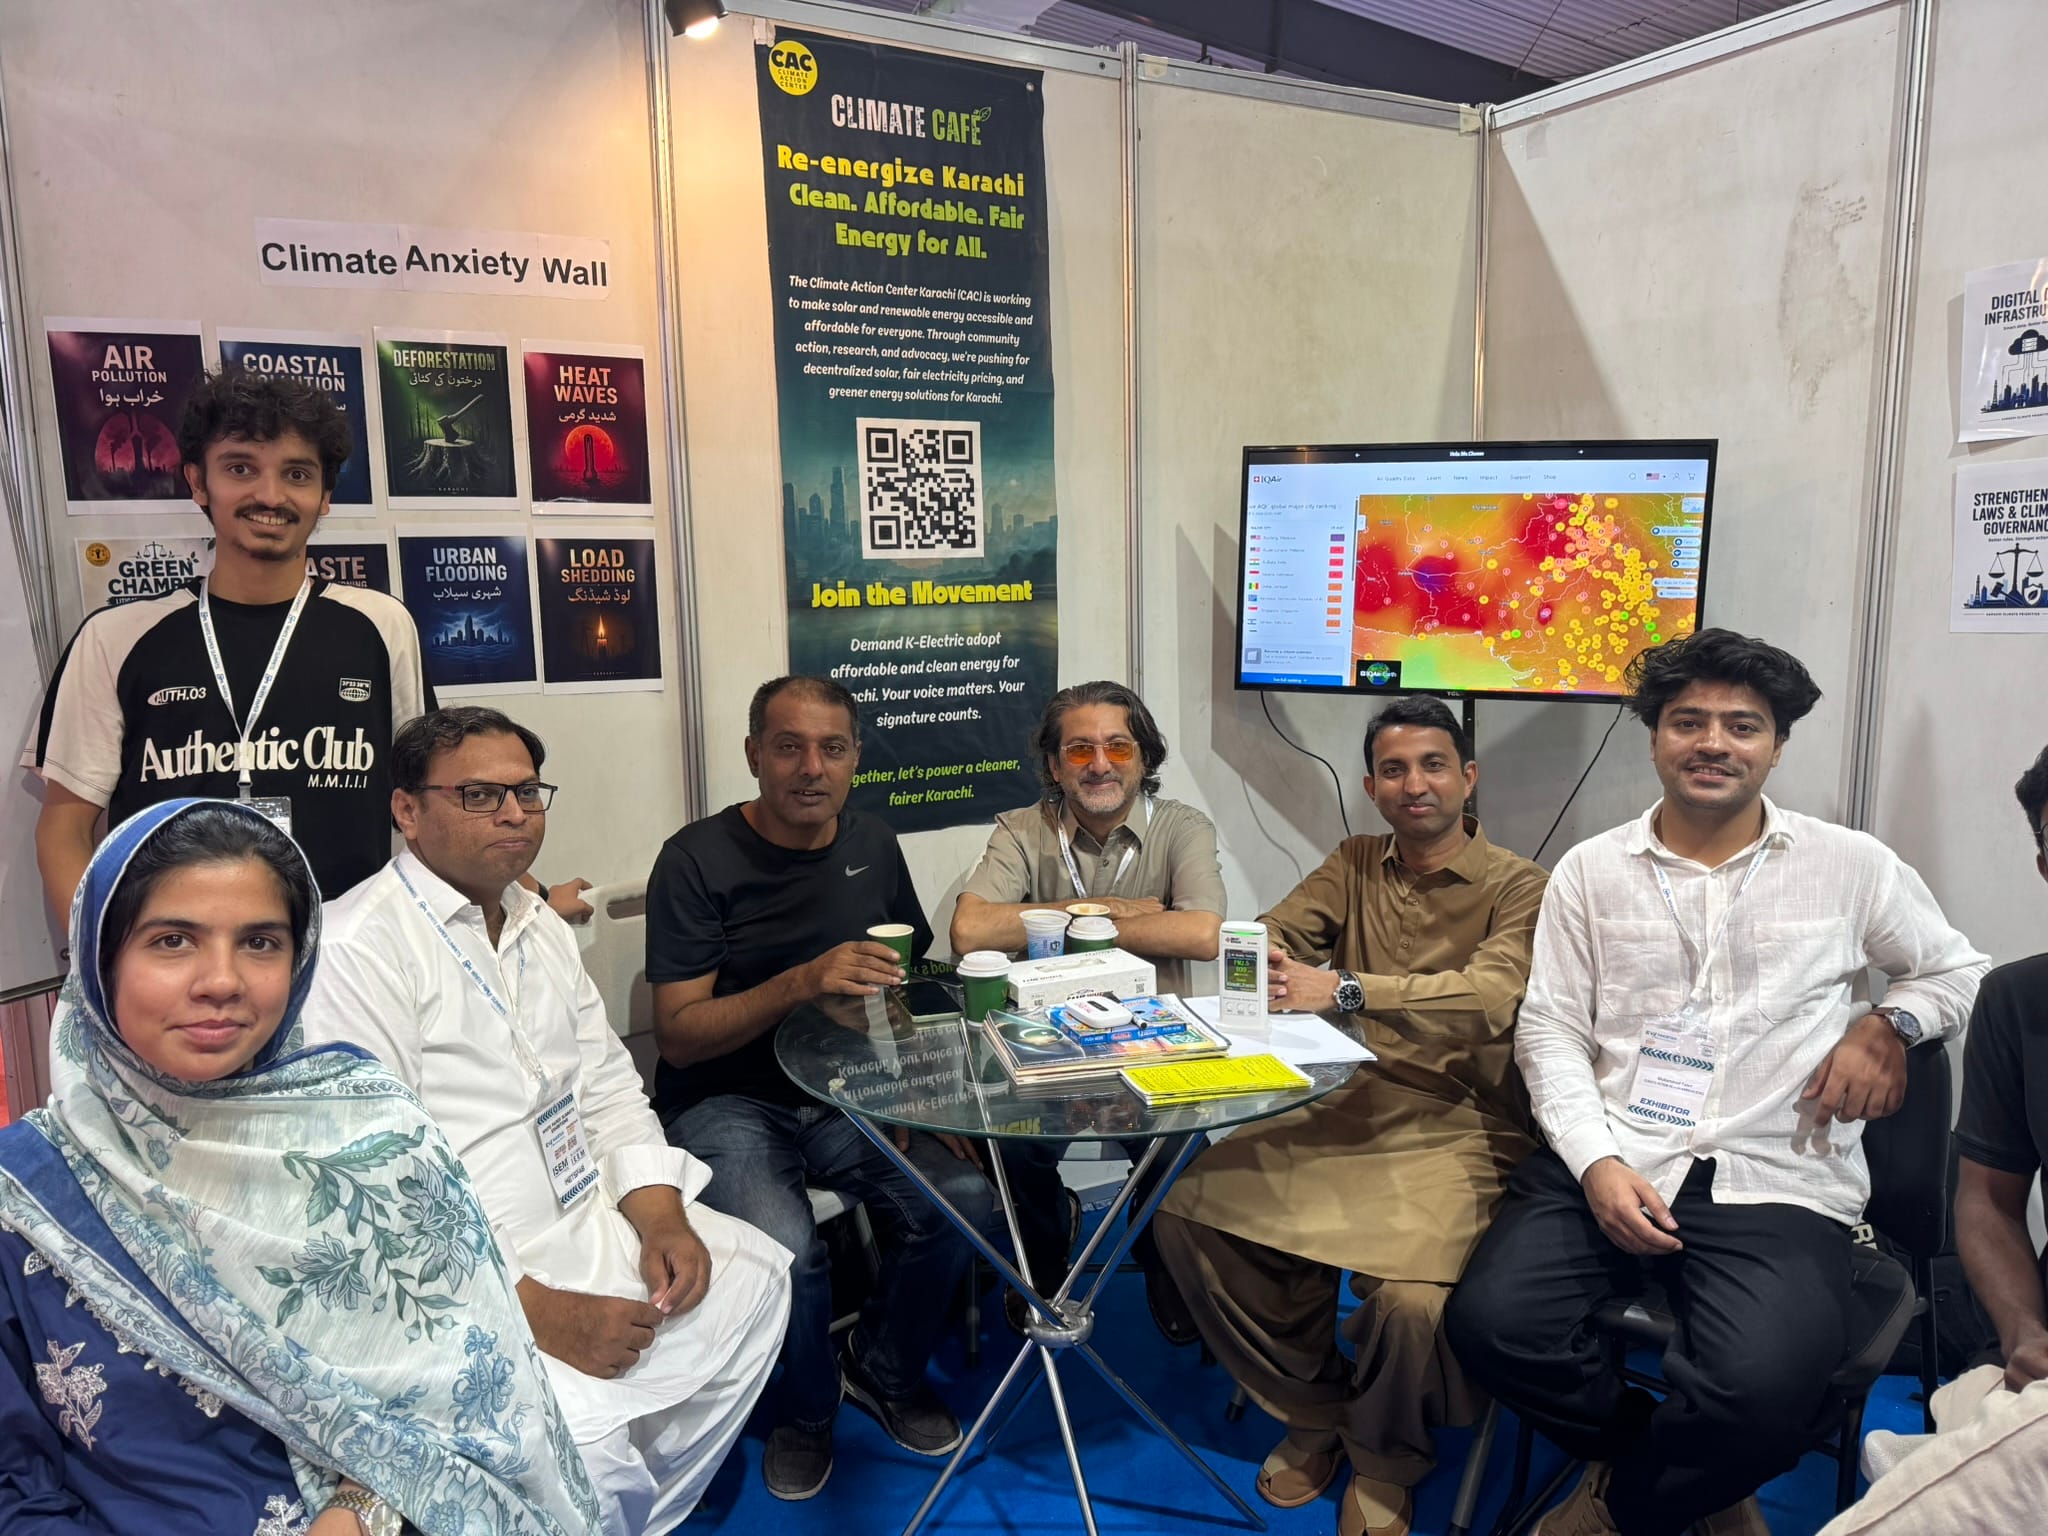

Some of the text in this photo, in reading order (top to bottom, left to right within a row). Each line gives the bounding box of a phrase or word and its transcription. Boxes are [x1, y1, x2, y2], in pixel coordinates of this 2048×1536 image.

[771, 50, 812, 71] CAC
[778, 69, 808, 78] CLIMATE
[780, 81, 807, 90] CENTER
[831, 94, 926, 138] CLIMATE
[777, 144, 1025, 197] Re-energize Karachi
[789, 183, 1025, 230] Clean. Affordable. Fair
[835, 222, 988, 259] Energy for All.
[262, 243, 607, 286] Climate Anxiety Wall
[789, 275, 1031, 307] The Climate Action Center Karachi (CAC) is working
[1991, 289, 2039, 310] DIGITAL
[789, 297, 1033, 326] to make solar and renewable energy accessible and
[805, 320, 1020, 347] affordable for everyone. Through community
[104, 345, 155, 370] AIR
[243, 353, 345, 376] COASTAL
[393, 349, 496, 371] DEFORESTATION
[796, 341, 1029, 367] action, research, and advocacy, we're pushing for
[92, 370, 167, 383] POLLUTION
[434, 373, 445, 386] کی
[559, 365, 611, 386] HEAT
[804, 363, 1024, 386] decentralized solar, fair electricity pricing, and
[123, 389, 164, 407] خراب
[554, 384, 618, 405] WAVES
[829, 387, 1003, 403] greener energy solutions for Karachi.
[558, 408, 617, 423] شدید گرمی
[1261, 475, 1282, 484] IQAir
[1974, 488, 2048, 506] STRENGTHEN
[1972, 506, 2005, 521] LAWS
[2008, 505, 2017, 519] &
[432, 547, 497, 565] URBAN
[570, 548, 624, 568] LOAD
[119, 560, 194, 578] GREEN
[305, 556, 367, 580] ASTE
[425, 564, 508, 582] FLOODING
[560, 569, 636, 583] SHEDDING
[433, 586, 502, 601] شہری سیلاب
[613, 589, 631, 604] لوڈ
[812, 580, 1032, 608] Join the Movement
[851, 632, 1001, 652] Demand K-Electric adopt
[831, 655, 1020, 679] affordable and clean energy for
[154, 687, 207, 704] AUTH.03
[851, 680, 1025, 703] chi. Your voice matters. Your
[876, 707, 982, 729] signature counts.
[140, 726, 375, 783] Authentic Club
[852, 757, 1021, 788] gether, let's power a cleaner,
[889, 785, 975, 806] fairer Karachi.
[1639, 1097, 1691, 1116] EXHIBITOR
[552, 1158, 569, 1176] ISEM
